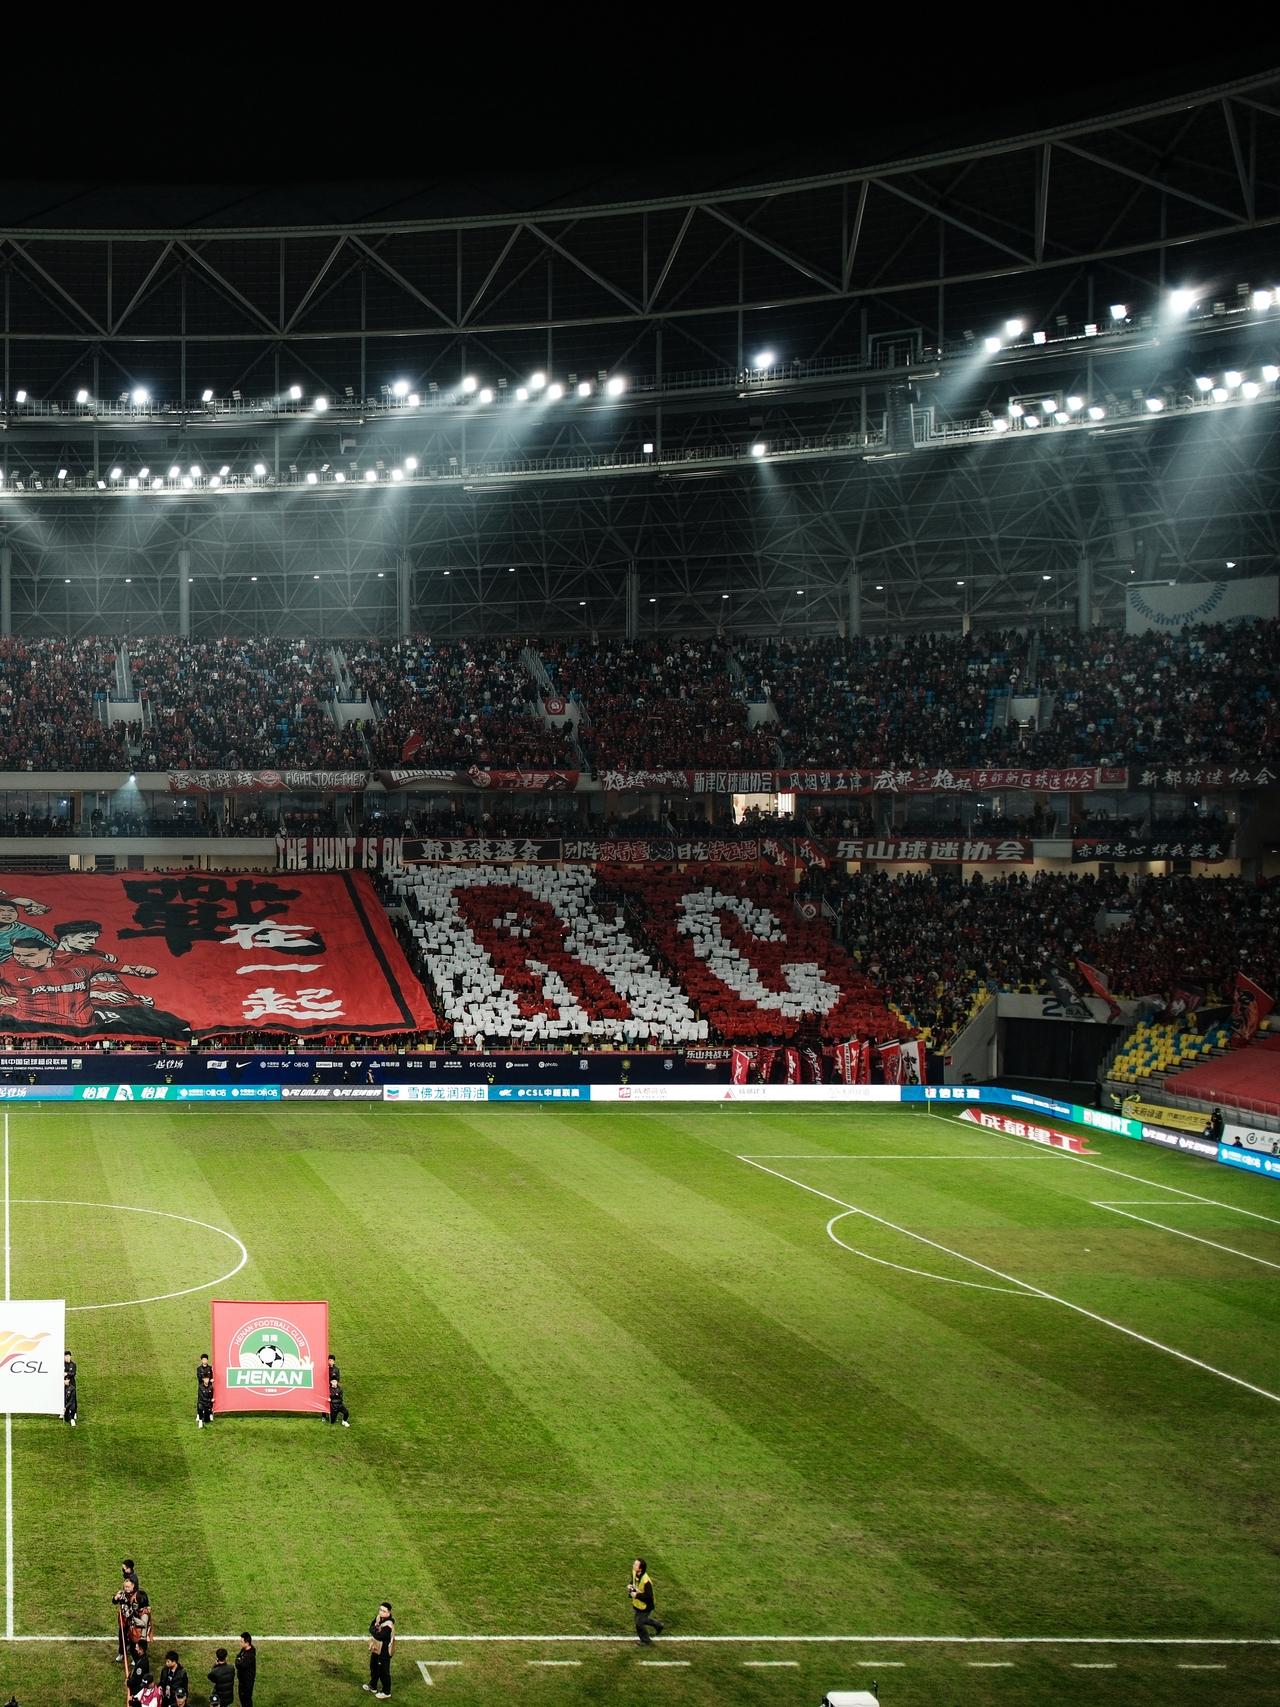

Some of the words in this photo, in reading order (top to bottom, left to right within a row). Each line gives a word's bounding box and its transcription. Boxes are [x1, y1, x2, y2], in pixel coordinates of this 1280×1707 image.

[286, 772, 312, 787] FIGHT
[694, 772, 773, 793] 新津区球迷协会
[788, 772, 863, 792] 风烟望五津
[873, 770, 913, 792] 成都
[930, 769, 972, 792] 雄起
[977, 771, 1093, 789] 东部新区球迷协会
[1138, 767, 1277, 788] 新都球迷协会
[276, 837, 307, 869] THE
[312, 837, 357, 869] HUNT
[362, 837, 378, 869] IS
[382, 837, 403, 869] ON
[835, 840, 1026, 861] 乐山球迷协会
[1076, 842, 1147, 858] 赤胆忠心
[1042, 998, 1062, 1017] 2
[686, 1050, 731, 1060] 乐山共战斗
[301, 1089, 330, 1097] ONLINE
[408, 1086, 485, 1099] 雪佛龙润滑油
[980, 1113, 1078, 1154] 成都建工
[234, 1324, 254, 1346] HENAN
[253, 1319, 291, 1332] FOOTBALL
[290, 1329, 305, 1347] CLUB
[9, 1360, 48, 1374] CSL
[236, 1370, 303, 1385] HENAN
